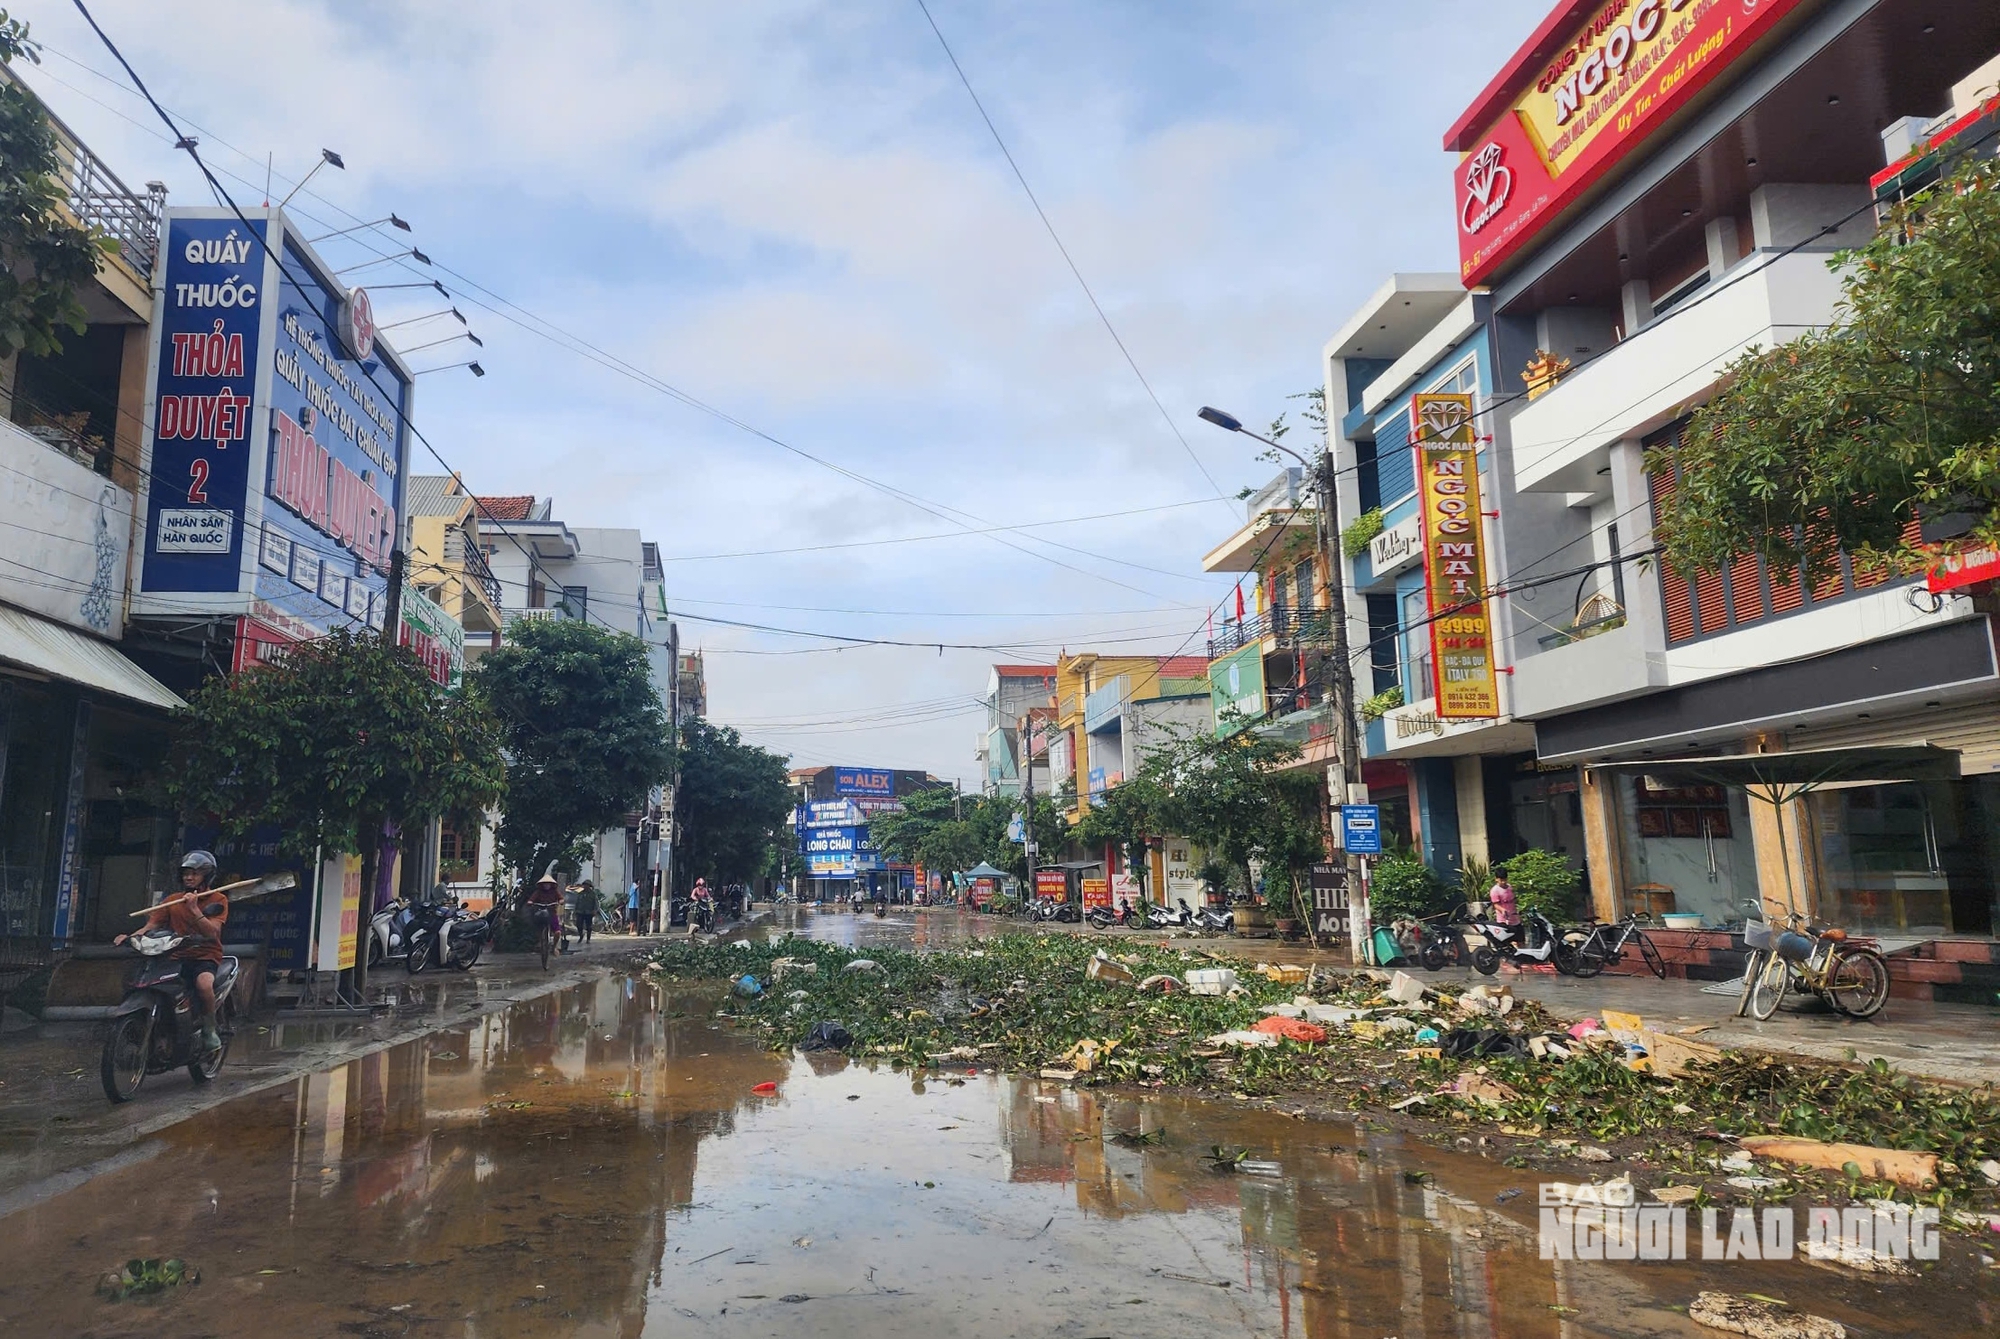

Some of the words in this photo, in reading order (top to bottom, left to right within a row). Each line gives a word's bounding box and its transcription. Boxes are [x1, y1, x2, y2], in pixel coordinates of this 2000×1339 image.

[1554, 0, 1664, 126] NGỌC
[1618, 112, 1632, 133] Uy
[1635, 95, 1652, 117] Tín
[1660, 59, 1686, 94] Chất
[1687, 27, 1724, 70] Lượng
[185, 229, 251, 264] QUẦY
[176, 274, 256, 308] THUỐC
[172, 318, 244, 377] THỎA
[285, 313, 297, 342] HỆ
[298, 327, 324, 366] THỐNG
[325, 355, 349, 391] THUỐC
[159, 387, 250, 449] DUYỆT
[276, 348, 305, 392] QUẦY
[306, 374, 338, 423] THUỐC
[338, 405, 356, 441] ĐẠT
[357, 426, 382, 467] CHUẨN
[382, 452, 397, 479] GPP
[187, 458, 209, 503] 2
[273, 408, 329, 533] THỎA
[329, 470, 385, 578] DUYỆT
[378, 506, 396, 577] 2
[1435, 460, 1469, 534] NGỌC
[167, 516, 197, 527] NHÂN
[190, 530, 223, 543] QUỐC
[1375, 530, 1409, 564] Wedding
[1437, 542, 1475, 595] MAI
[855, 773, 889, 789] ALEX
[807, 840, 828, 851] LONG
[829, 836, 852, 851] CHÂU
[1170, 849, 1188, 862] Hi
[1169, 868, 1195, 879] style
[1313, 865, 1331, 874] NHÀ
[1314, 877, 1350, 909] HIỀ
[1318, 913, 1340, 932] ÁO
